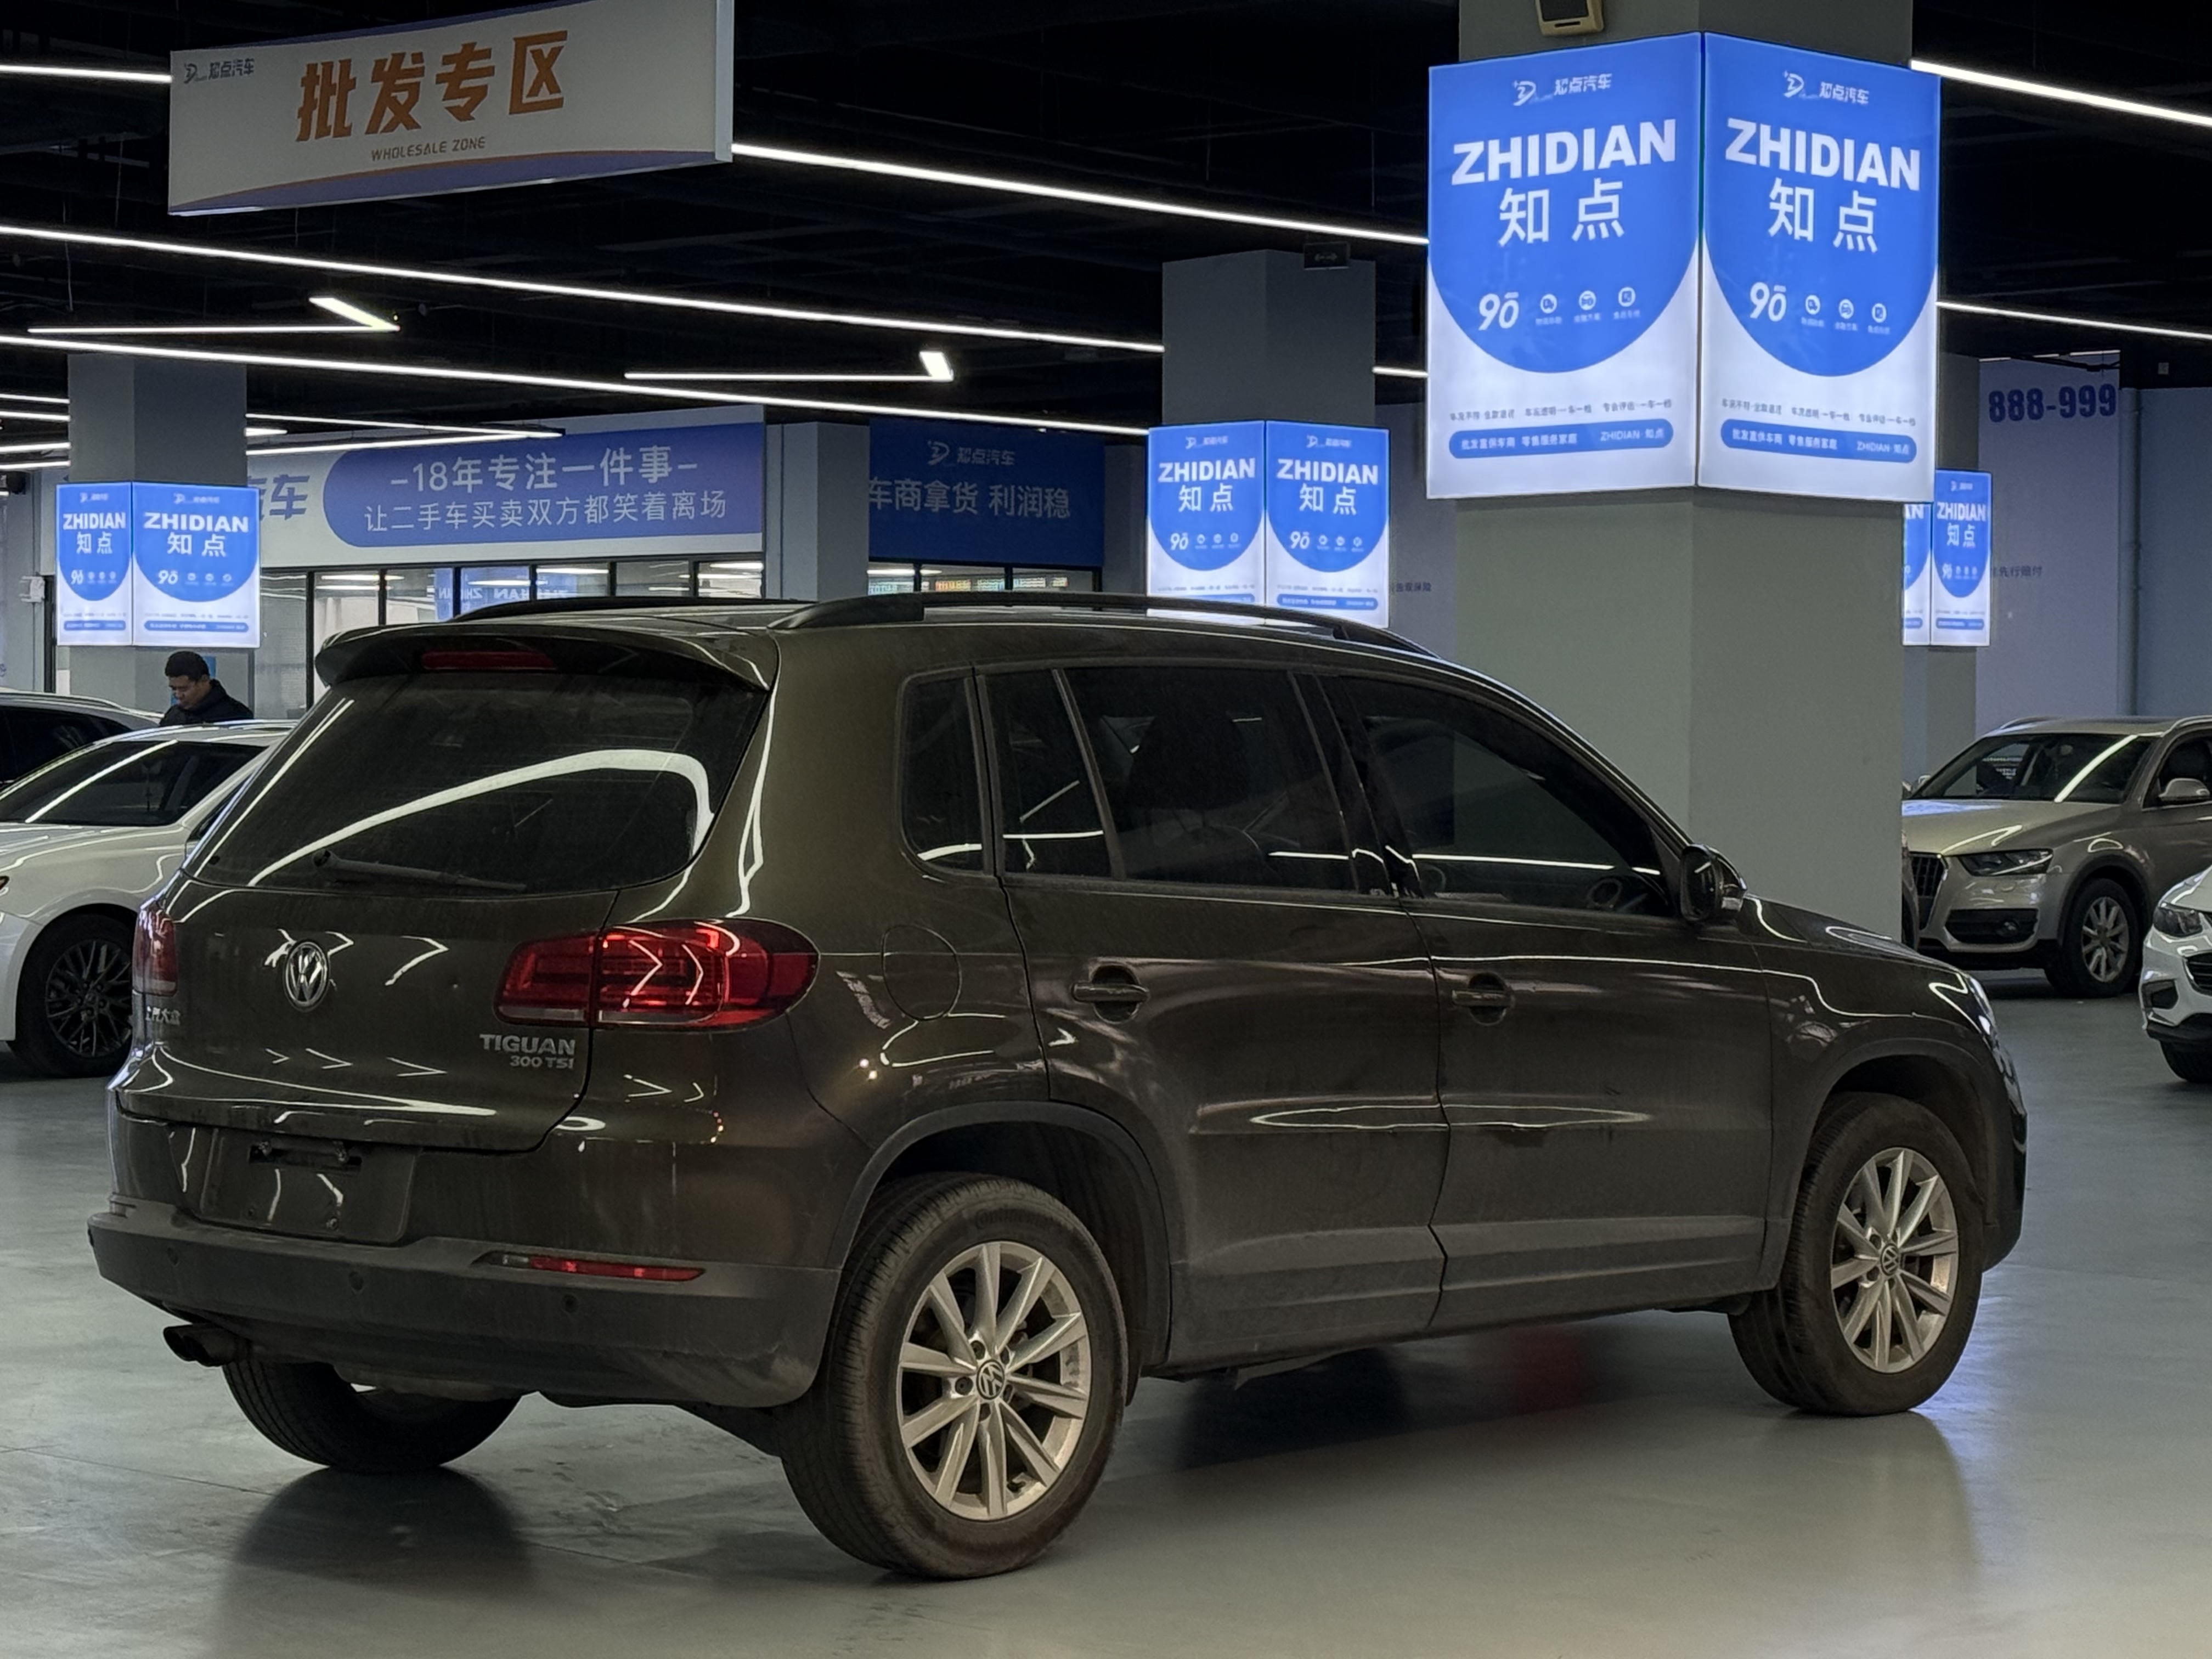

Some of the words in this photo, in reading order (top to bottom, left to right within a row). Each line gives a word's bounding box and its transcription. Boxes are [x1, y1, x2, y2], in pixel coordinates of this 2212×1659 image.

[296, 30, 568, 142] 批发专区
[1554, 73, 1612, 97] 知点汽车
[1820, 82, 1869, 105] 知点汽车
[371, 140, 447, 161] WHOLESALE
[453, 136, 486, 153] ZONE
[1451, 120, 1676, 185] ZHIDIAN
[1725, 118, 1920, 191] ZHIDIAN
[1498, 178, 1625, 246] 知点
[1768, 177, 1878, 253] 知点
[1479, 292, 1519, 331] 90
[1750, 282, 1786, 322] 90
[1988, 383, 2117, 422] 888-999
[957, 447, 1016, 466] 知点汽车
[1158, 458, 1256, 483] ZHIDIAN
[1277, 459, 1379, 485] ZHIDIAN
[365, 490, 726, 532] 让二手车买卖双方都笑着离场
[870, 476, 978, 515] 车商拿货
[989, 484, 1070, 520] 利润稳
[1178, 483, 1234, 513] 知点
[1299, 483, 1357, 516] 知点
[63, 512, 126, 530] ZHIDIAN
[144, 512, 249, 533] ZHIDIAN
[1937, 502, 1987, 521] ZHIDIAN
[76, 532, 113, 555] 知点
[167, 532, 227, 557] 知点
[1947, 522, 1976, 548] 知点
[479, 1034, 575, 1056] TIGUAN
[510, 1056, 543, 1068] 300
[545, 1057, 574, 1069] TSI
